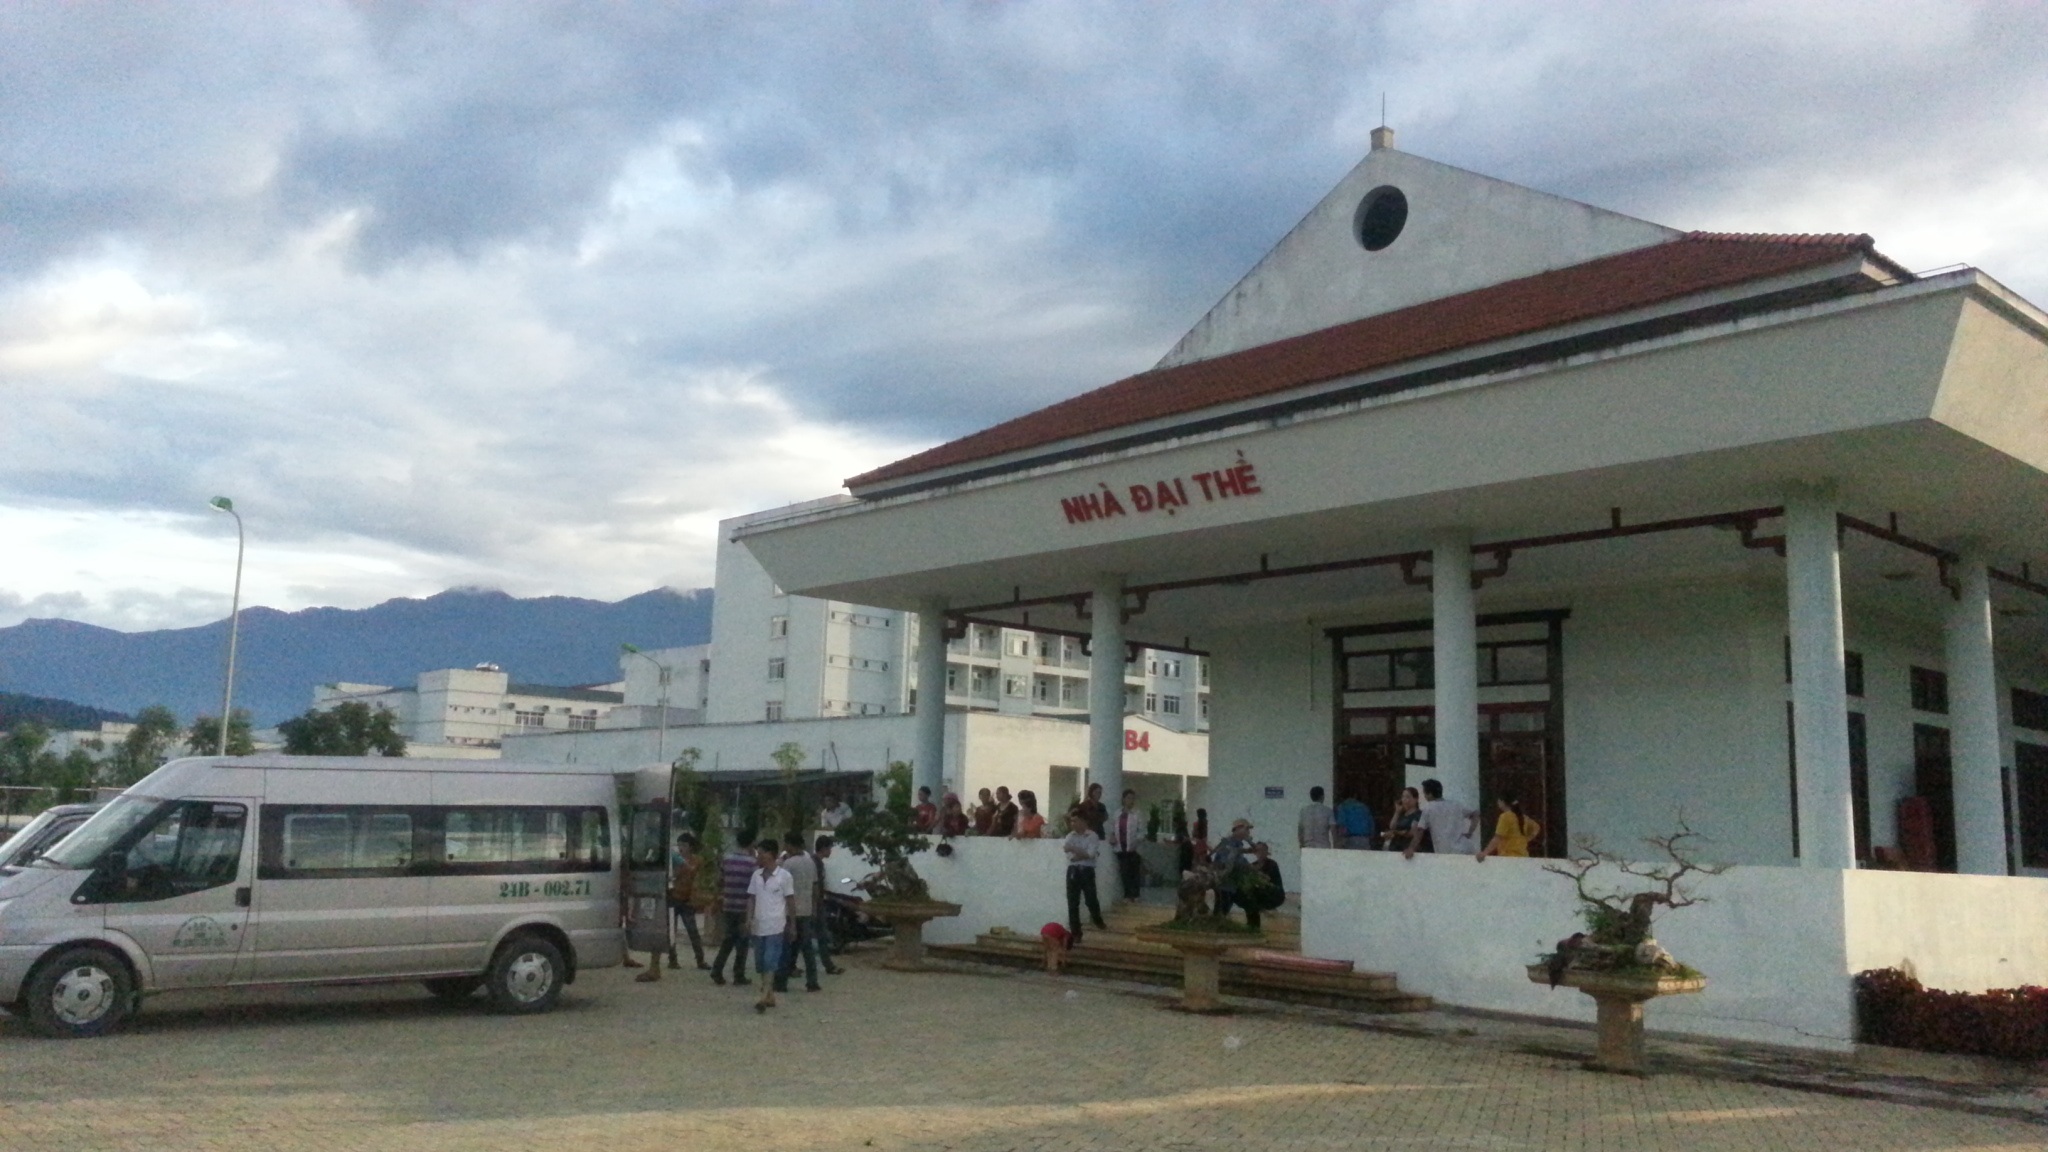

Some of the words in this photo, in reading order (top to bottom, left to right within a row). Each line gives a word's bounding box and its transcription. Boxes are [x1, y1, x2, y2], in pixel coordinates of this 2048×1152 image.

[1061, 482, 1126, 524] NHÀ
[1129, 477, 1188, 516] ĐẠI
[1125, 729, 1150, 752] B4
[499, 881, 530, 898] 24B
[543, 880, 591, 896] 002.71
